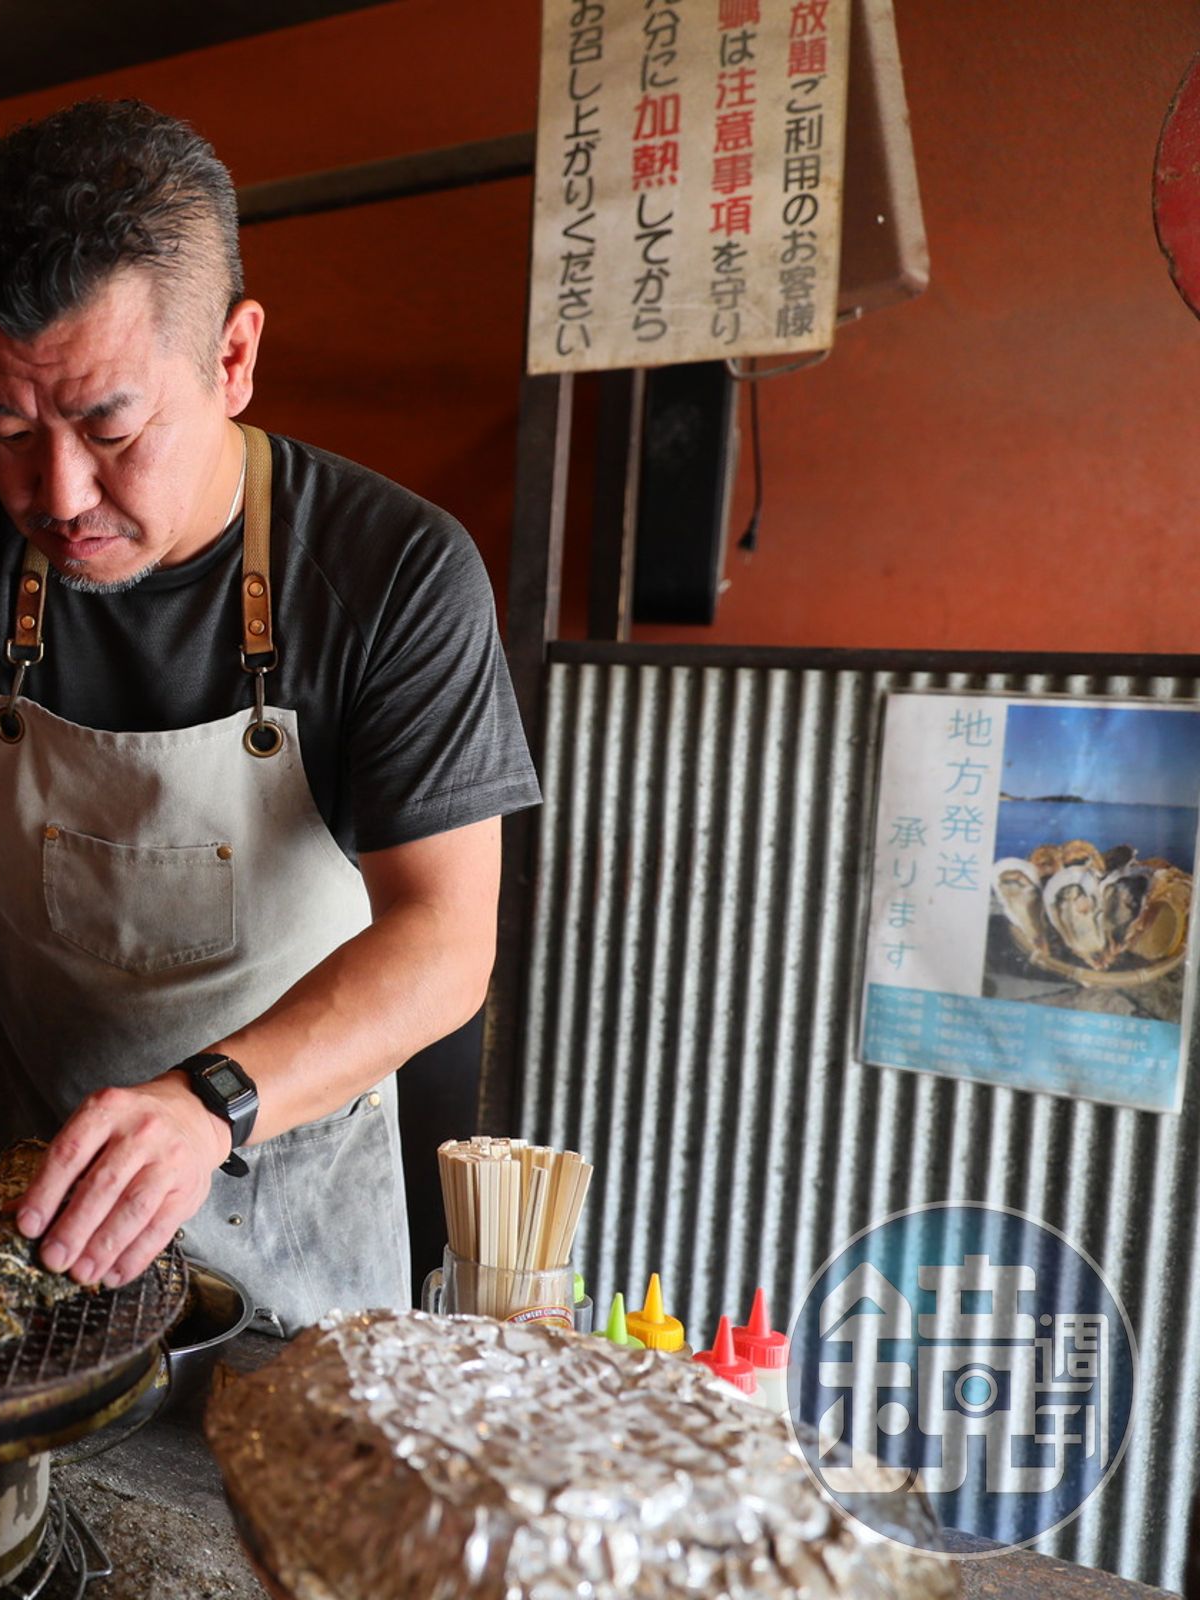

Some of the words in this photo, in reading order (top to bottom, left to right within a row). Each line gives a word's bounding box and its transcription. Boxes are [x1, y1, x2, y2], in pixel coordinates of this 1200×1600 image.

[631, 0, 681, 343] 分に加熱してから
[776, 0, 830, 339] 放題ご利用のお客様
[881, 815, 929, 971] 承ります
[935, 707, 992, 892] 地方発送
